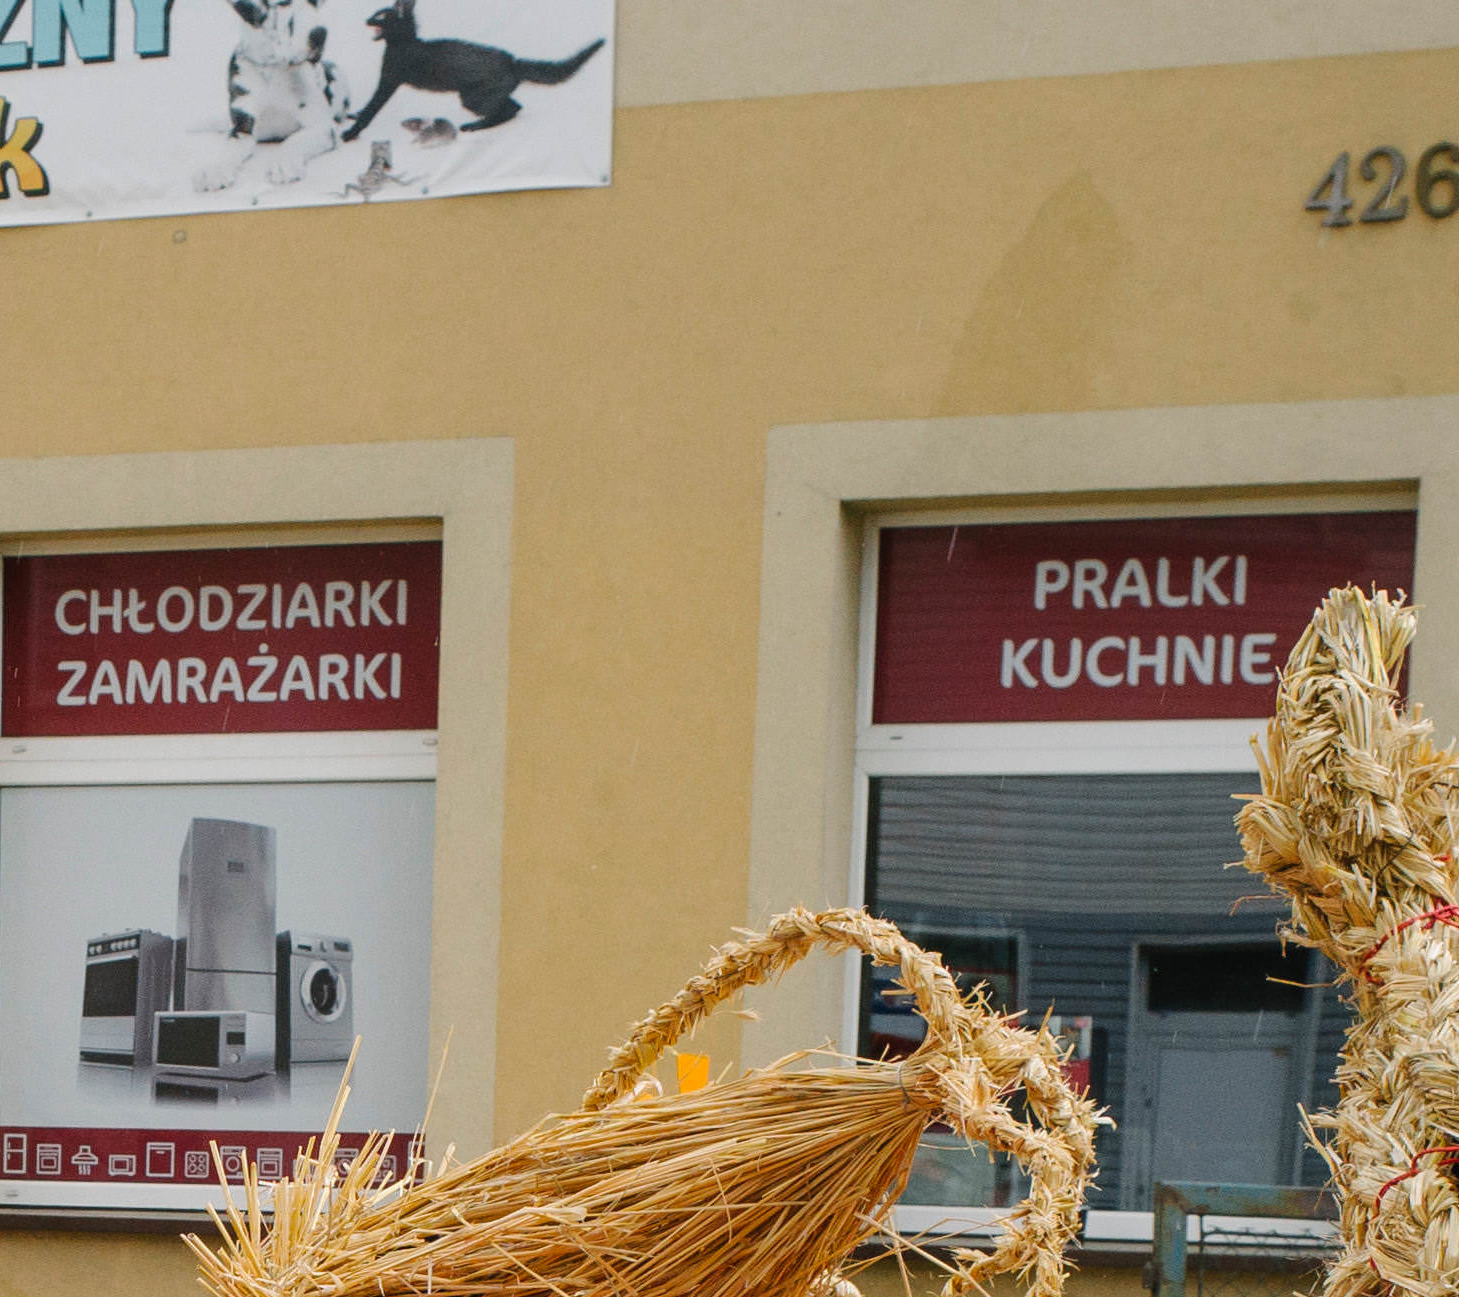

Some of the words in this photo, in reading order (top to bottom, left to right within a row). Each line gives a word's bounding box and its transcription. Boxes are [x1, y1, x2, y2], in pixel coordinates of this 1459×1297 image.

[54, 578, 409, 635] CHŁODZIARKI
[1034, 555, 1249, 610] PRALKI
[56, 643, 402, 706] ZAMRAŻARKI
[999, 633, 1277, 690] KUCHNIE
